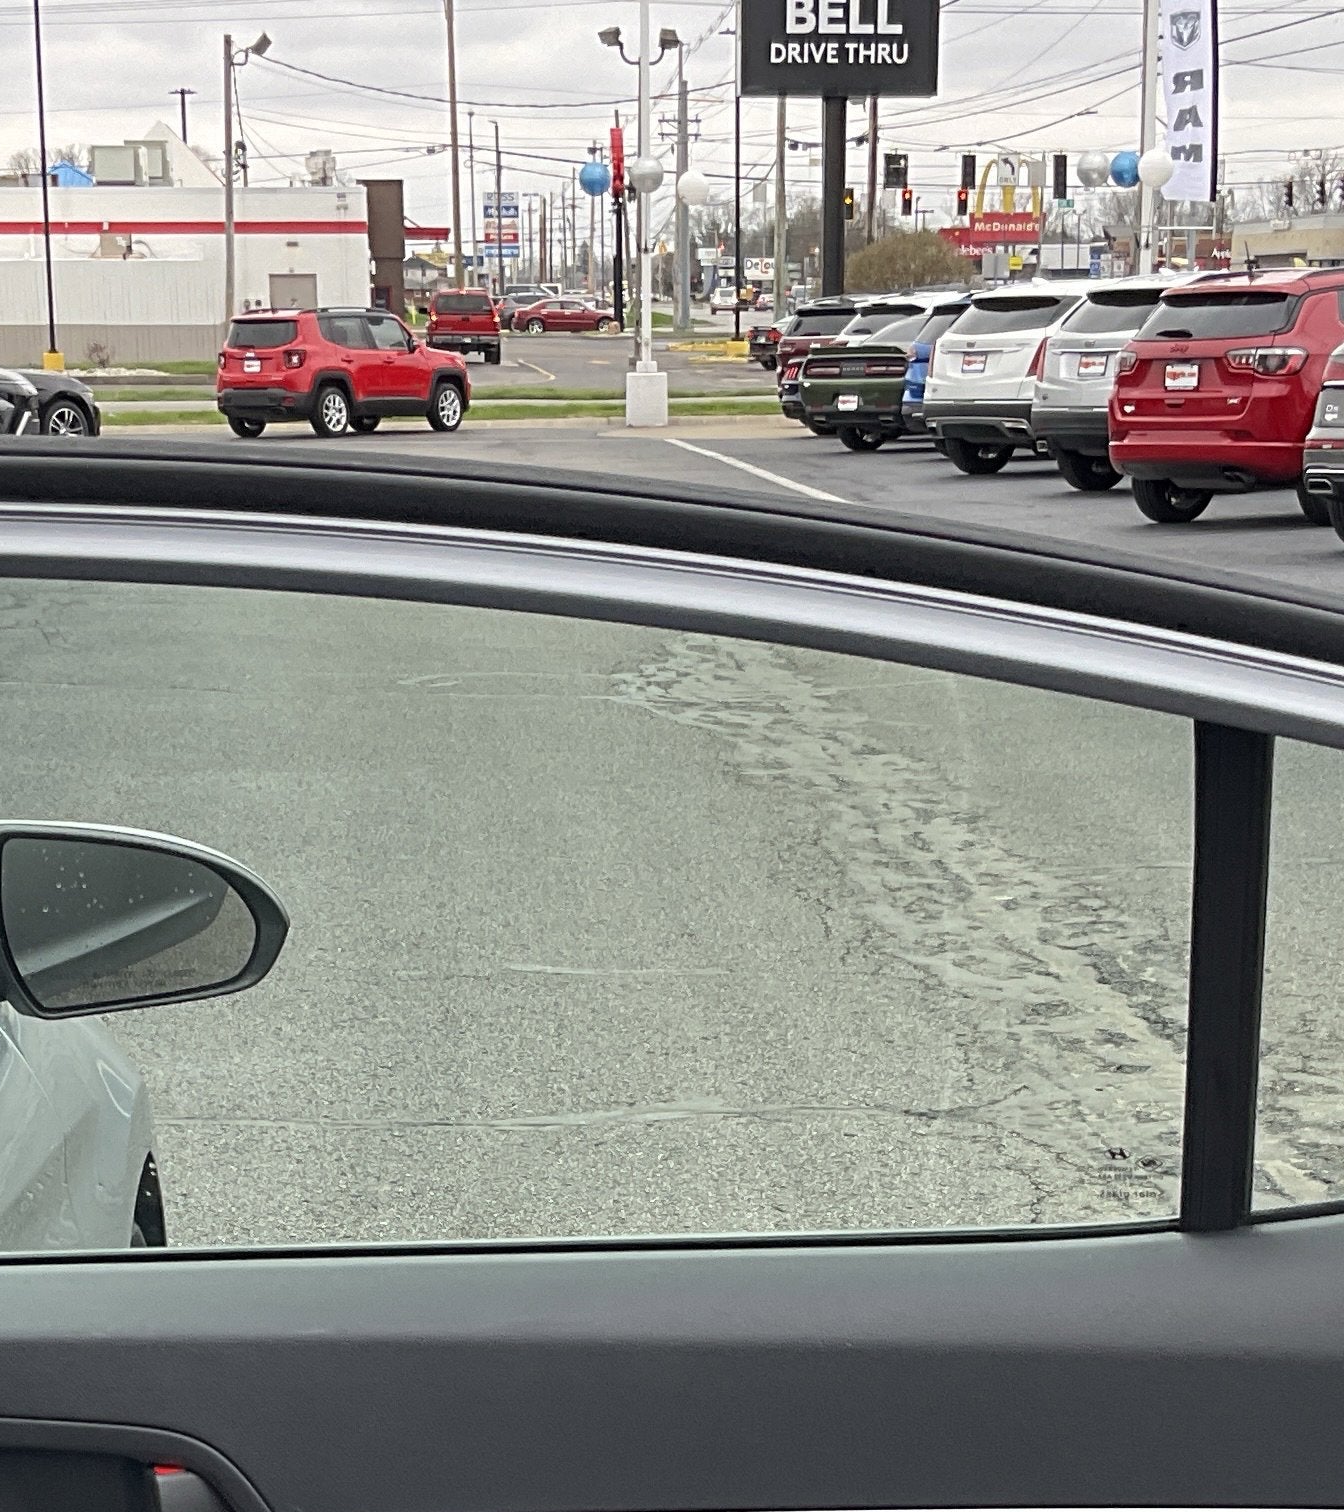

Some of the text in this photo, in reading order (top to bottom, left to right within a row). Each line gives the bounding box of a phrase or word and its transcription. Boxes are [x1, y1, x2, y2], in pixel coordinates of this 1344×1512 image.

[786, 0, 903, 35] BELL
[770, 42, 909, 64] DRIVE THRU
[486, 192, 515, 201] RSS
